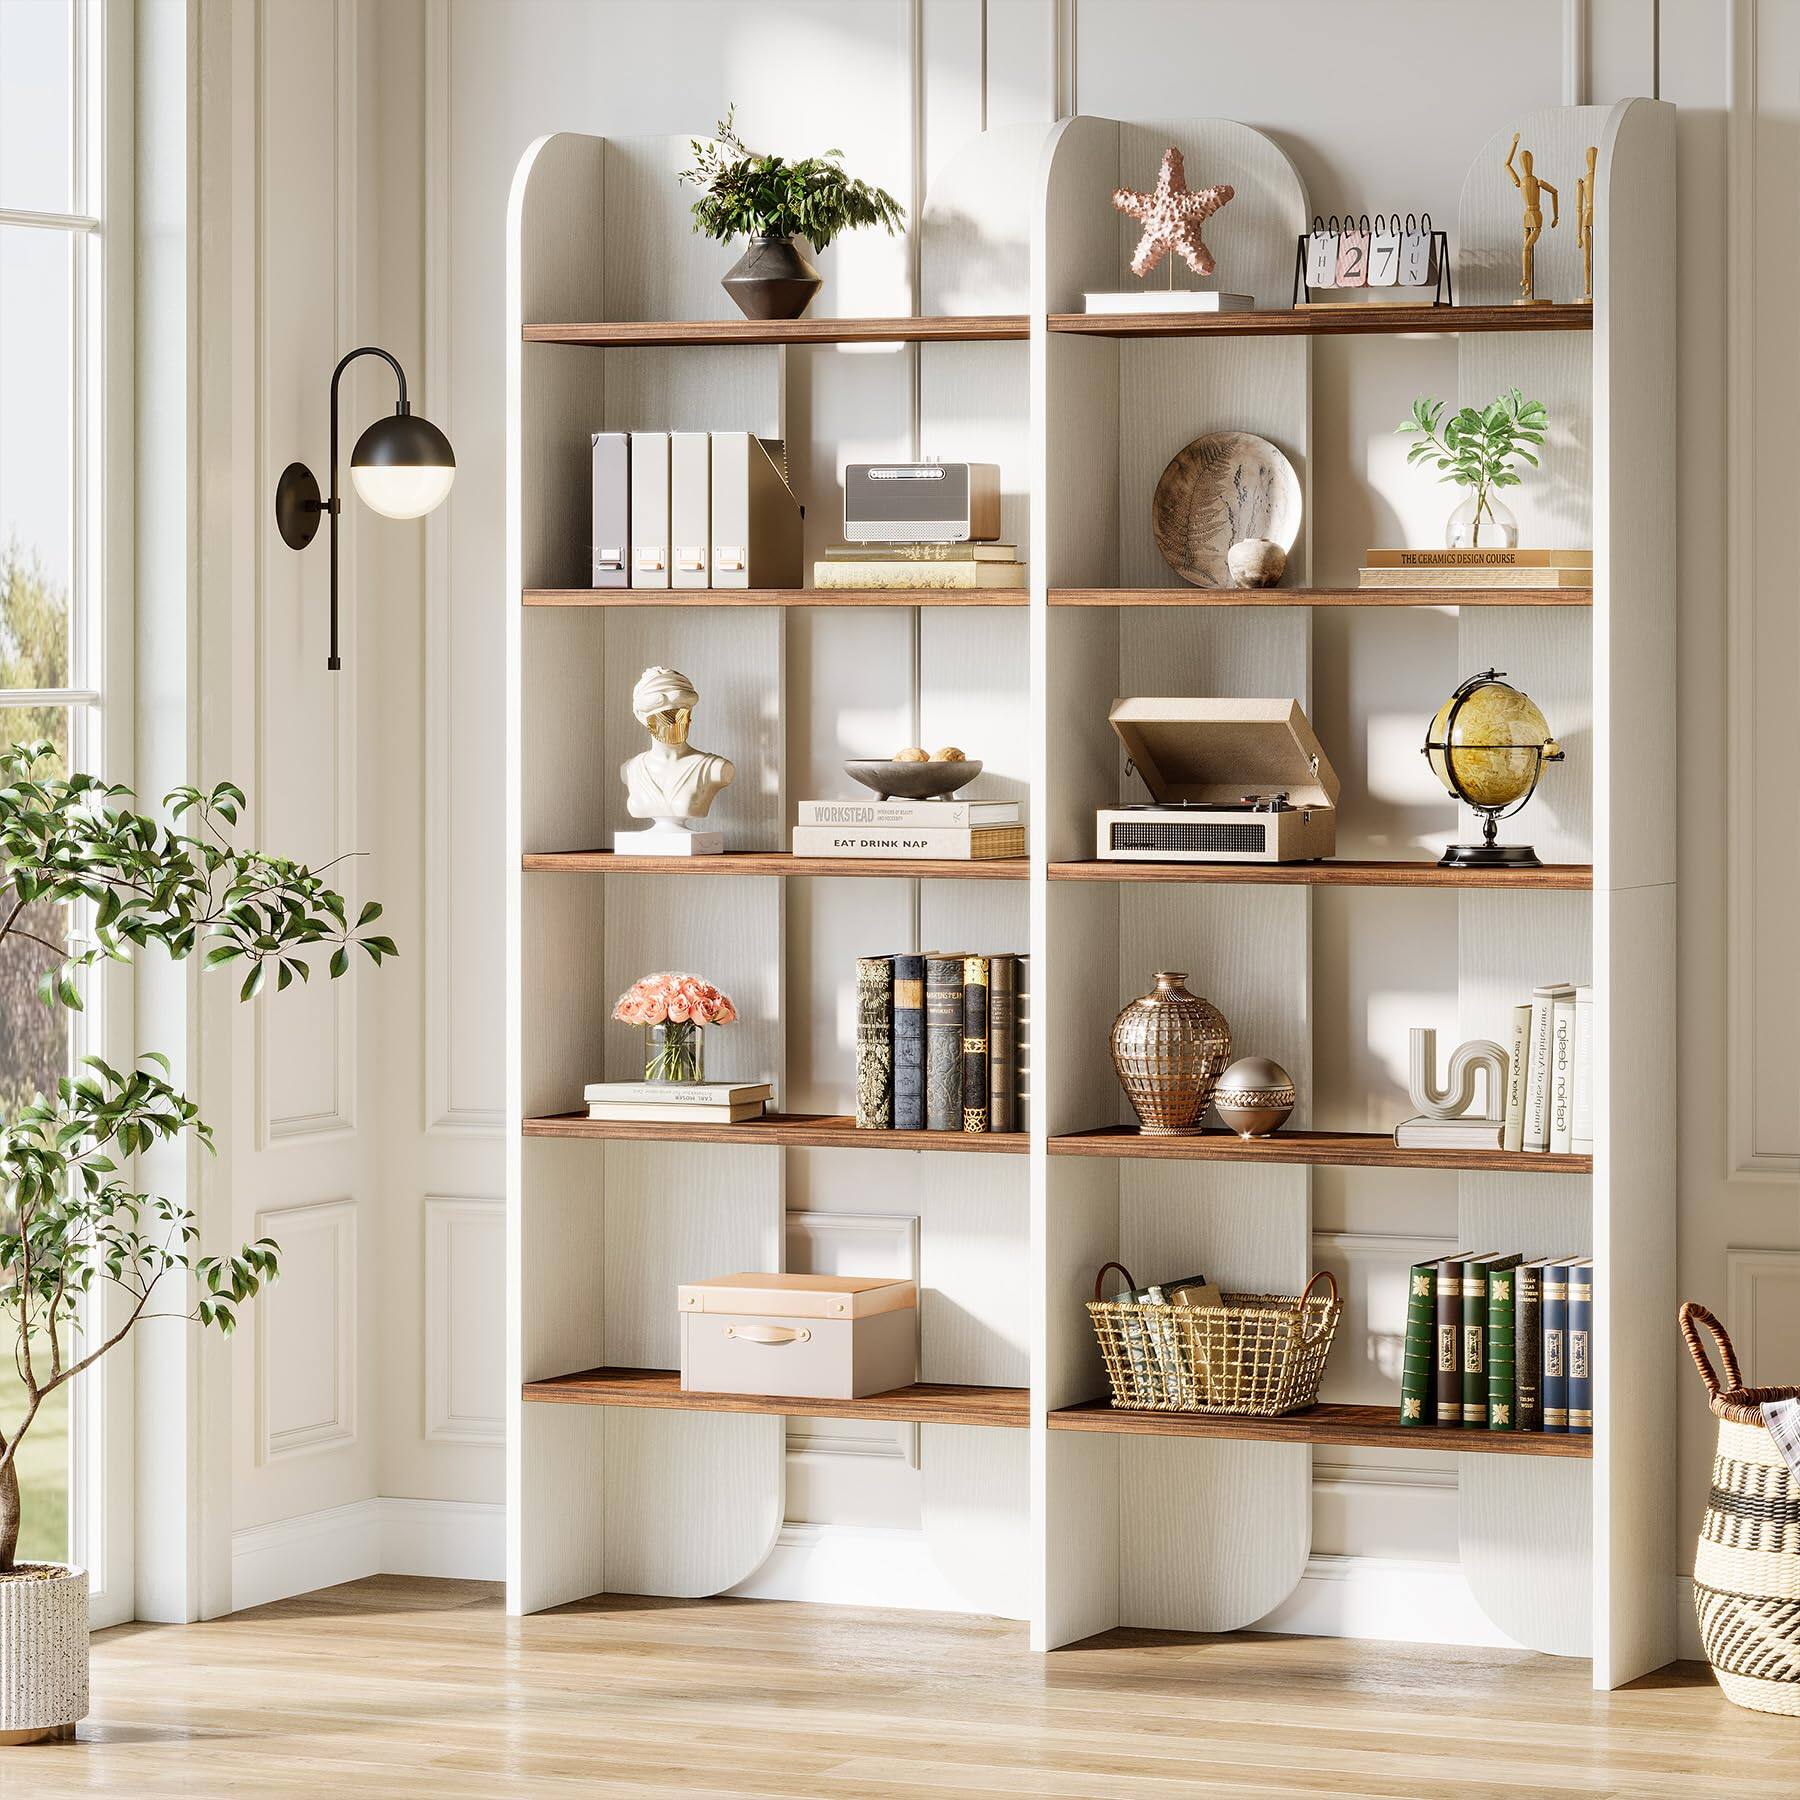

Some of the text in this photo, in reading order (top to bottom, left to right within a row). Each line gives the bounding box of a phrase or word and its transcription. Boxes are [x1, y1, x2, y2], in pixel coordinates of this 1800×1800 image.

[1317, 238, 1328, 284] THU
[1408, 235, 1420, 282] JUN
[1401, 553, 1515, 564] THE CERAMICS DESIGN COURSE
[814, 806, 874, 823] WORKSTEAD
[834, 839, 928, 848] EAT DRINK NAP
